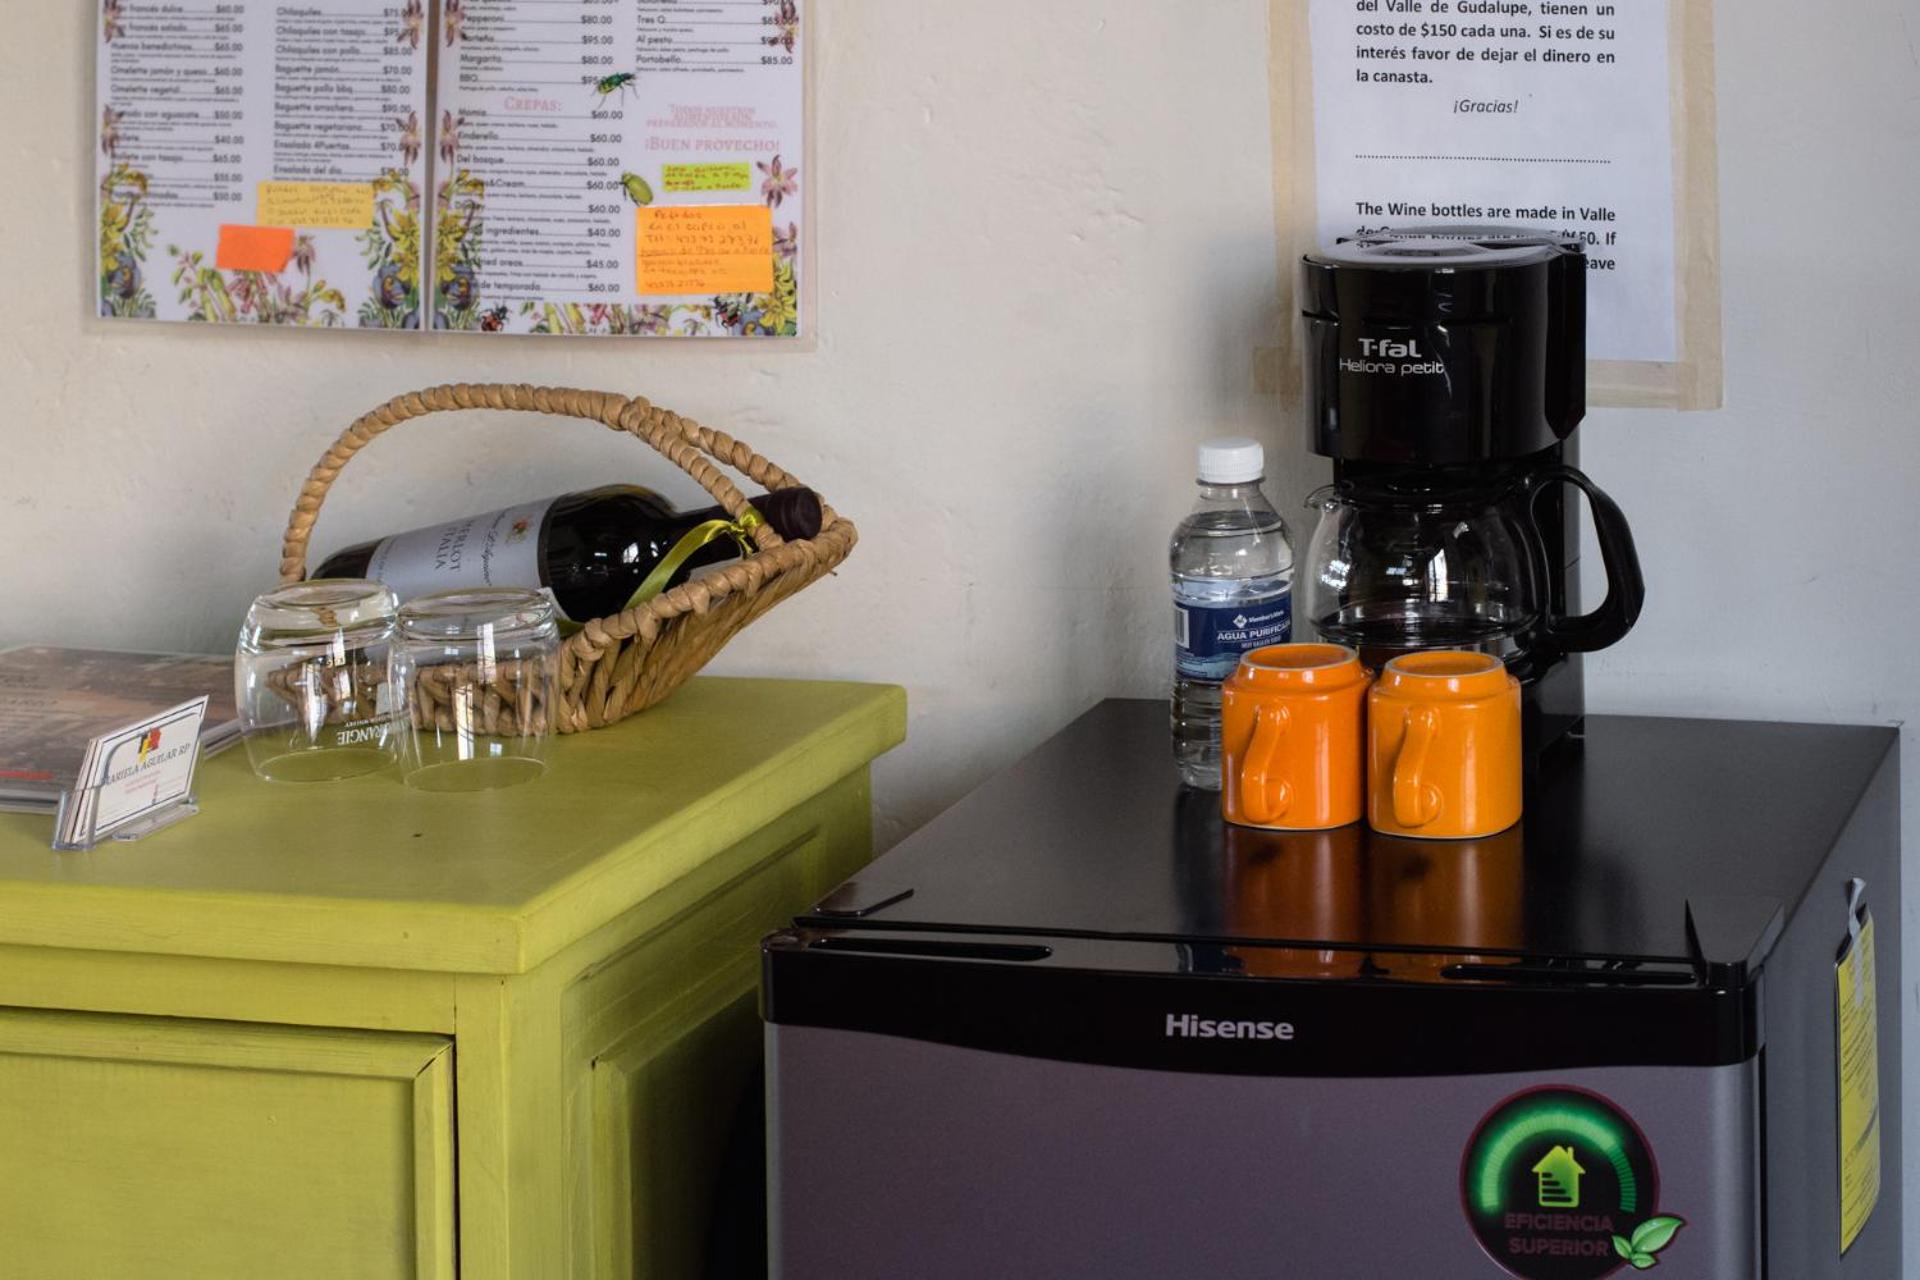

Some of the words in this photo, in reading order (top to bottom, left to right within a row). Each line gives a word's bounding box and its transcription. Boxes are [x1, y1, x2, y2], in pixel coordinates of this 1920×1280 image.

[276, 7, 322, 17] Chilaquiles
[1356, 0, 1379, 12] del
[1386, 0, 1423, 13] Valle
[1430, 0, 1449, 13] de
[1457, 0, 1533, 17] Gudalupe,
[1540, 0, 1588, 15] tienen
[1596, 5, 1615, 16] un
[581, 15, 613, 25] $80.00
[276, 26, 321, 36] Chilaquiles
[1356, 24, 1395, 37] costo
[1398, 23, 1417, 37] de
[1420, 22, 1457, 39] $150
[1461, 24, 1496, 38] cada
[1500, 26, 1532, 38] una.
[1539, 25, 1552, 38] Si
[1555, 28, 1573, 40] es
[1576, 25, 1595, 40] de
[1599, 28, 1615, 40] su
[582, 35, 614, 45] $95.00
[636, 35, 645, 43] Al
[648, 35, 673, 46] pesto
[275, 45, 321, 55] Chilaquiles
[1356, 45, 1406, 60] interés
[1411, 45, 1451, 60] favor
[1456, 46, 1475, 61] de
[1481, 47, 1519, 64] dejar
[1524, 47, 1537, 62] el
[1542, 48, 1591, 63] dinero
[1597, 52, 1615, 64] en
[582, 55, 614, 65] $80.00
[636, 55, 682, 64] Portobello
[761, 56, 793, 65] $85.00
[274, 64, 312, 75] Baguette
[459, 73, 478, 82] BBQ
[1356, 69, 1369, 83] la
[1373, 70, 1434, 84] canasta.
[274, 83, 312, 93] Baguette
[274, 102, 312, 112] Baguette
[1453, 99, 1519, 114] ¡Gracias!
[591, 110, 623, 120] $60.00
[274, 121, 311, 132] Baguette
[590, 133, 622, 143] $60.00
[274, 140, 311, 149] Ensalada
[457, 153, 471, 162] Del
[473, 153, 504, 165] bosque
[587, 157, 619, 167] $60.00
[273, 165, 311, 174] Ensalada
[586, 181, 619, 190] $60.00
[588, 204, 621, 214] $60.00
[1356, 202, 1383, 216] The
[1387, 202, 1427, 217] Wine
[1431, 203, 1483, 218] bottles
[1487, 207, 1511, 219] are
[1516, 205, 1557, 220] made
[1562, 206, 1576, 220] in
[1579, 207, 1616, 222] Valle
[486, 227, 540, 236] ingredientes
[587, 228, 621, 238] $40.00
[1606, 232, 1617, 246] If
[586, 260, 619, 270] $45.00
[1585, 258, 1616, 271] eave
[494, 281, 541, 292] temporada
[588, 283, 620, 293] $60.00
[1358, 338, 1422, 358] T-fal
[1339, 358, 1396, 374] Heliora
[1401, 361, 1445, 376] petit
[1217, 631, 1247, 641] AGUA
[1166, 1014, 1294, 1040] Hisense
[1504, 1212, 1614, 1231] EFICIENCIA
[1509, 1237, 1610, 1257] SUPERIOR
